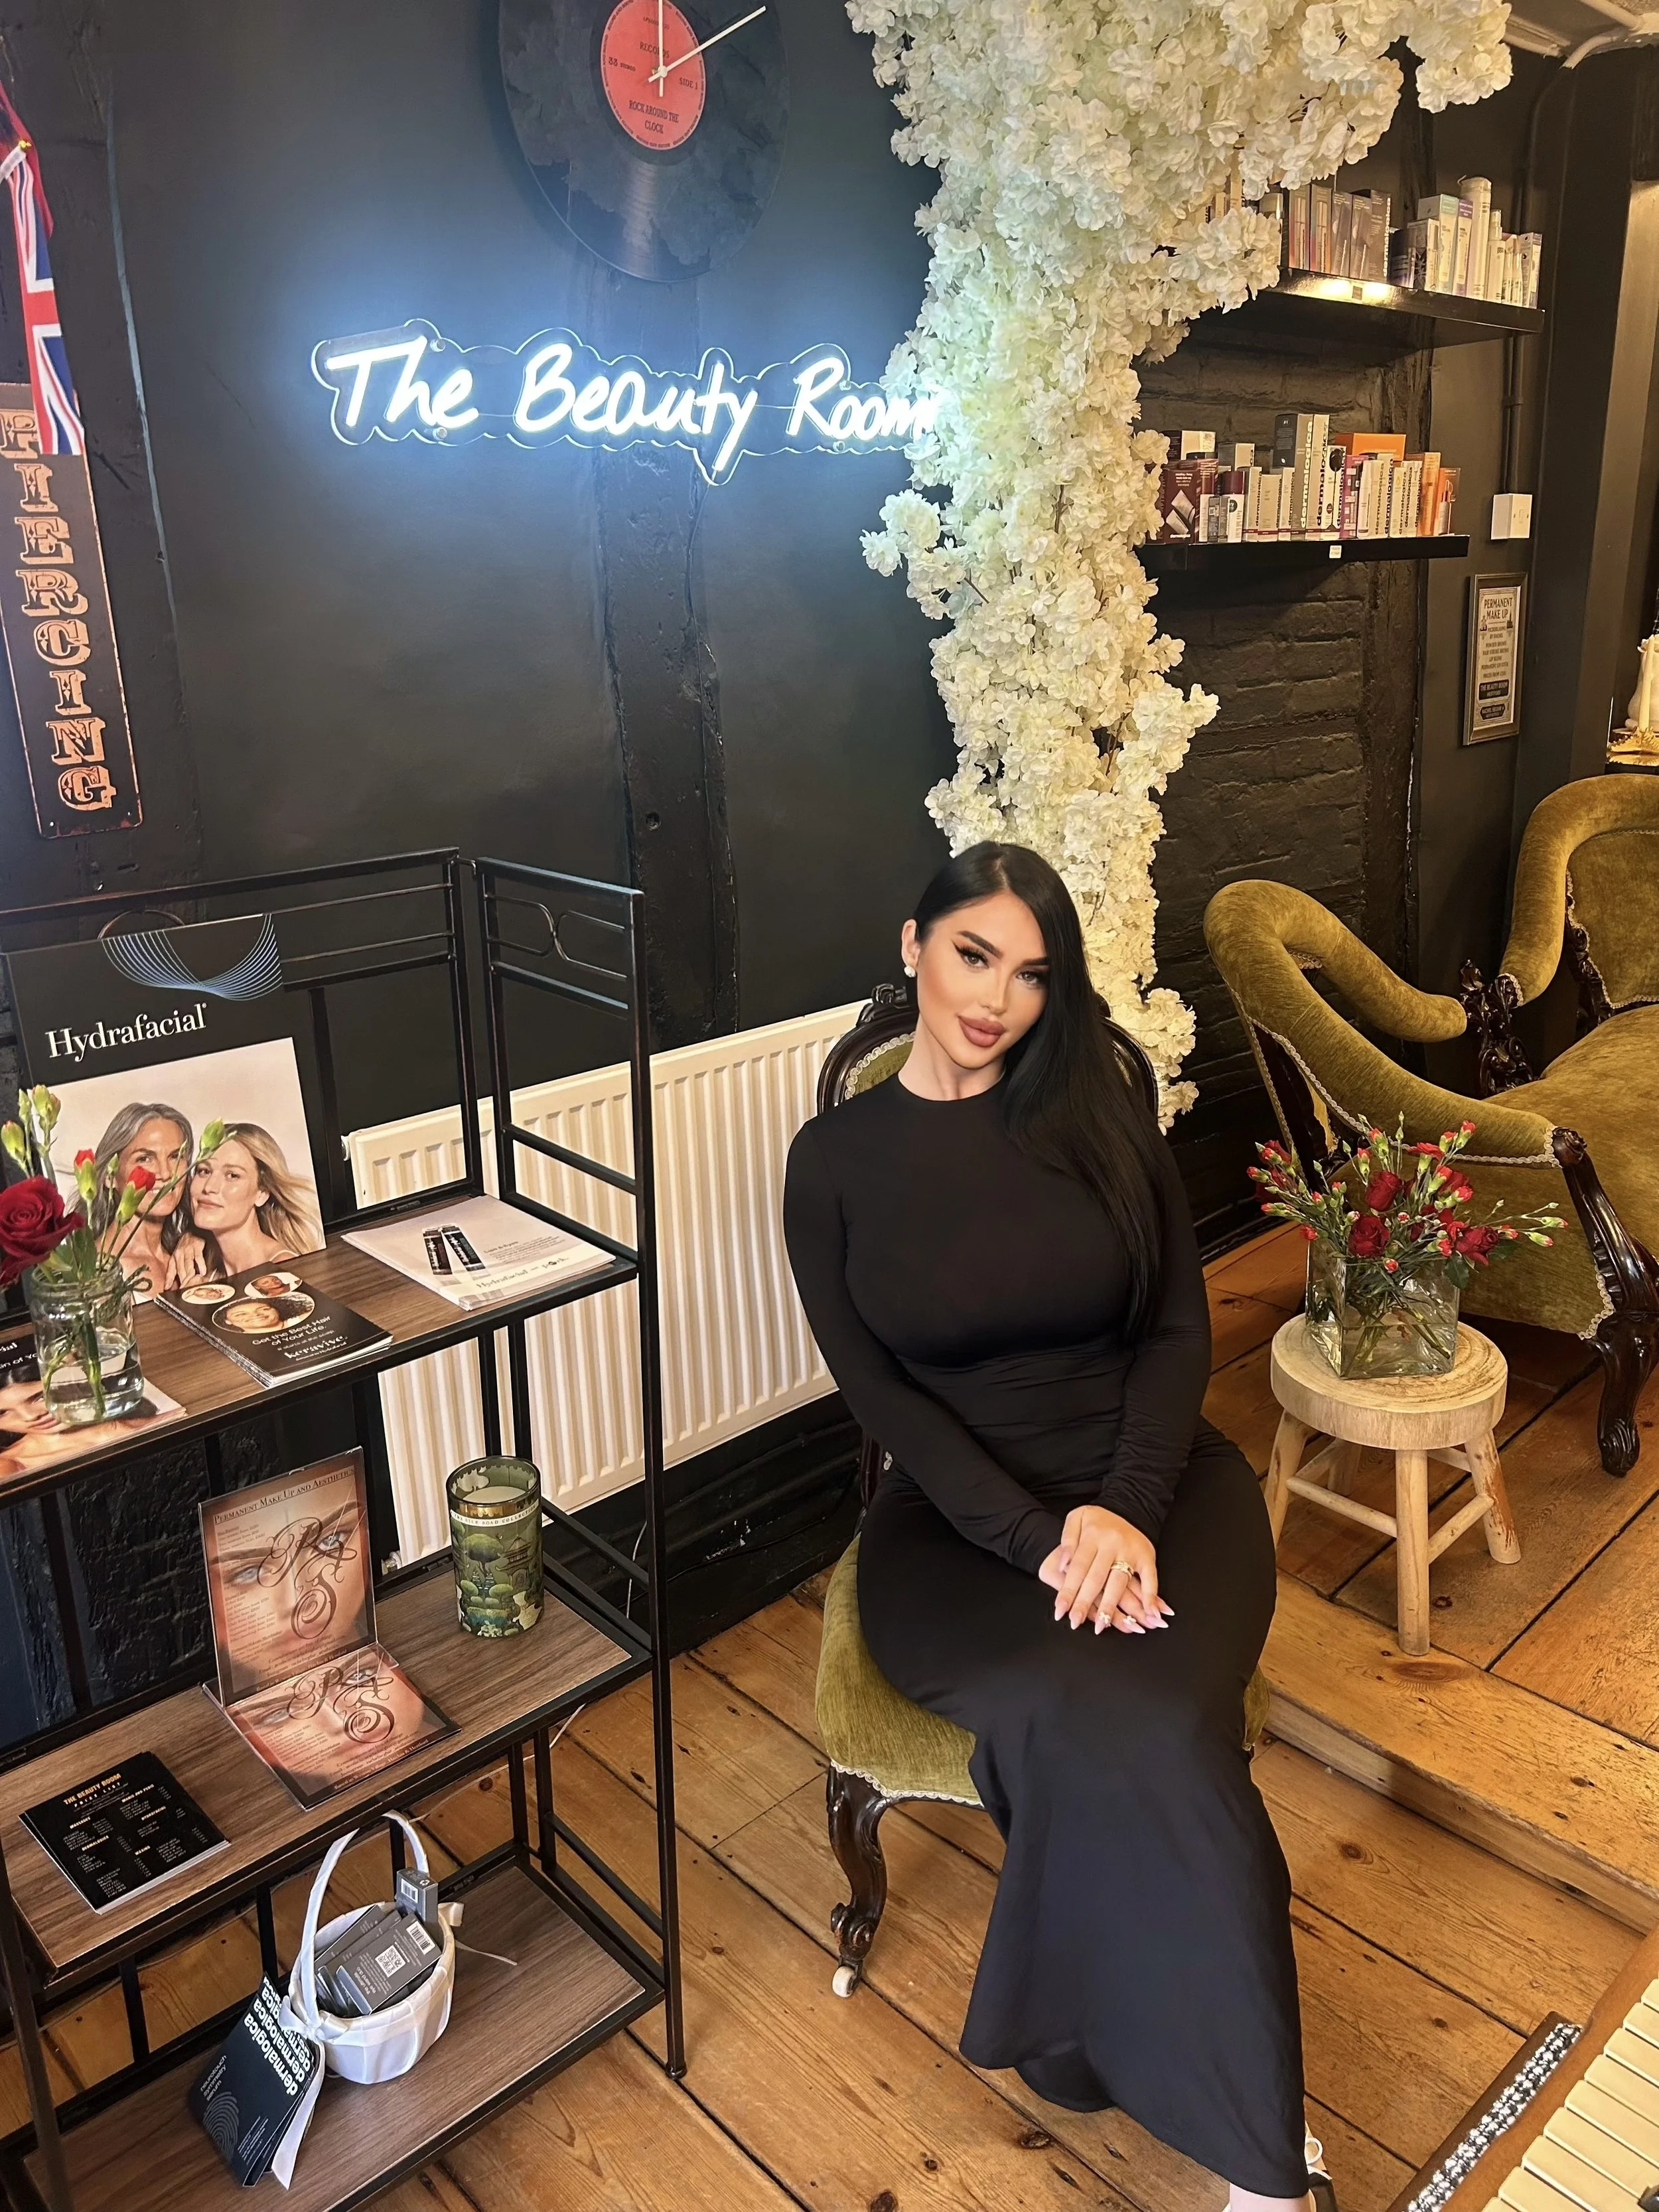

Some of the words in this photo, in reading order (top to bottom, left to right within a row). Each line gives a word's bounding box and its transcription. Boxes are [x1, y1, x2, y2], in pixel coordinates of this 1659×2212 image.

[608, 56, 618, 67] 33
[639, 41, 670, 59] RECODS
[679, 77, 694, 88] SIDE
[628, 100, 644, 113] ROCK
[645, 104, 668, 120] AROUND
[668, 111, 680, 123] THE
[644, 119, 664, 134] CLOCK
[325, 335, 479, 429] The
[514, 342, 757, 473] Beauty
[786, 357, 938, 441] Room
[1300, 421, 1313, 528] dermalogica
[0, 409, 117, 812] PIERCING
[1484, 597, 1513, 609] PERMANENT
[1486, 609, 1500, 620] MAKE
[1501, 609, 1508, 619] UP
[271, 1331, 289, 1340] the
[288, 1323, 312, 1335] Best
[311, 1315, 331, 1326] Hair
[281, 1332, 304, 1342] Your
[305, 1325, 327, 1335] Life.
[214, 1501, 259, 1524] PERMANENT
[260, 1494, 283, 1507] MAKE
[283, 1489, 295, 1500] UP
[296, 1485, 312, 1494] AND
[313, 1468, 355, 1488] AESTHETICS
[63, 1795, 77, 1805] THE
[76, 1783, 101, 1799] BEAUTY
[101, 1773, 121, 1787] ROOM
[74, 1793, 98, 1808] PRICE
[103, 1781, 121, 1793] LIST
[253, 1998, 305, 2083] dermalogica
[244, 2012, 299, 2096] dermalogica
[200, 2055, 227, 2091] neurotouch
[203, 2064, 227, 2097] symmetry
[206, 2079, 222, 2101] serum
